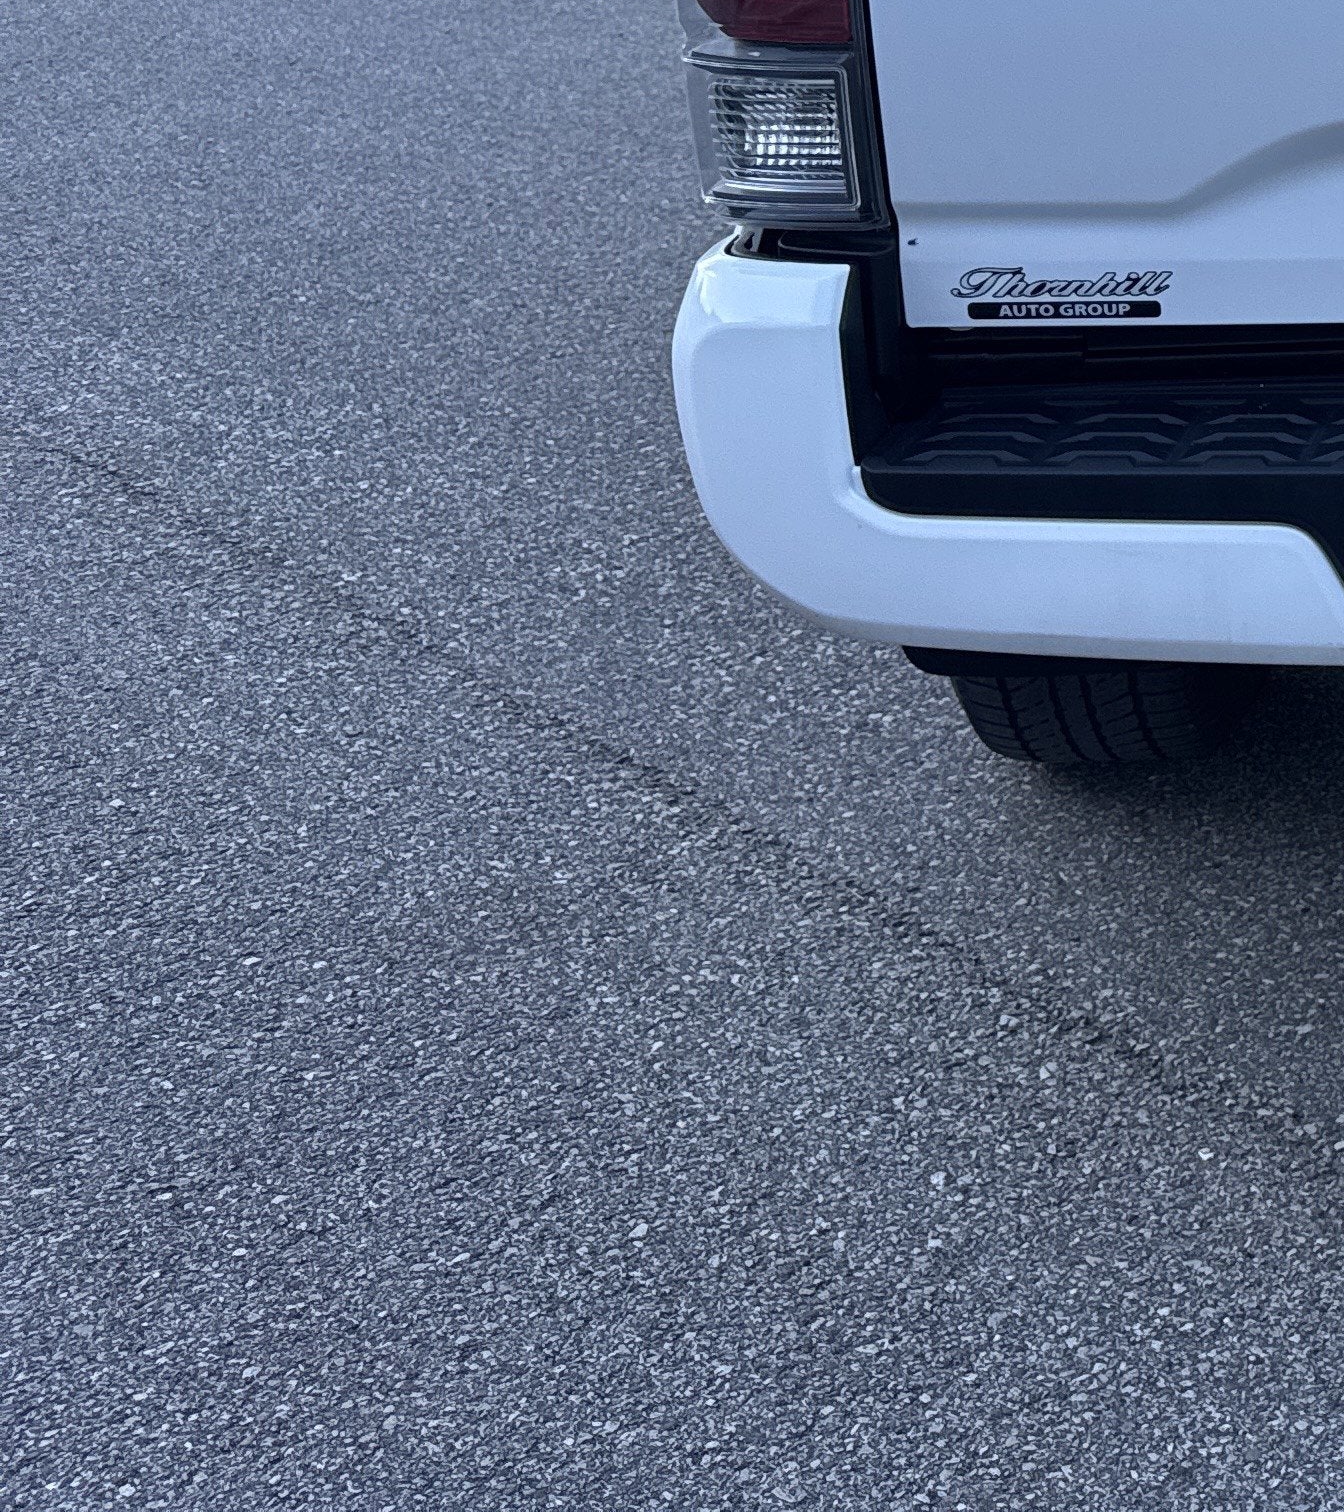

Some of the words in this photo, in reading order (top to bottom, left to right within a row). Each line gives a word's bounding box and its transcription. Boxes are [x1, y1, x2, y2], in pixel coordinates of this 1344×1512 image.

[950, 267, 1173, 298] Thornhill
[999, 304, 1053, 317] AUTO
[1059, 303, 1131, 317] GROUP
